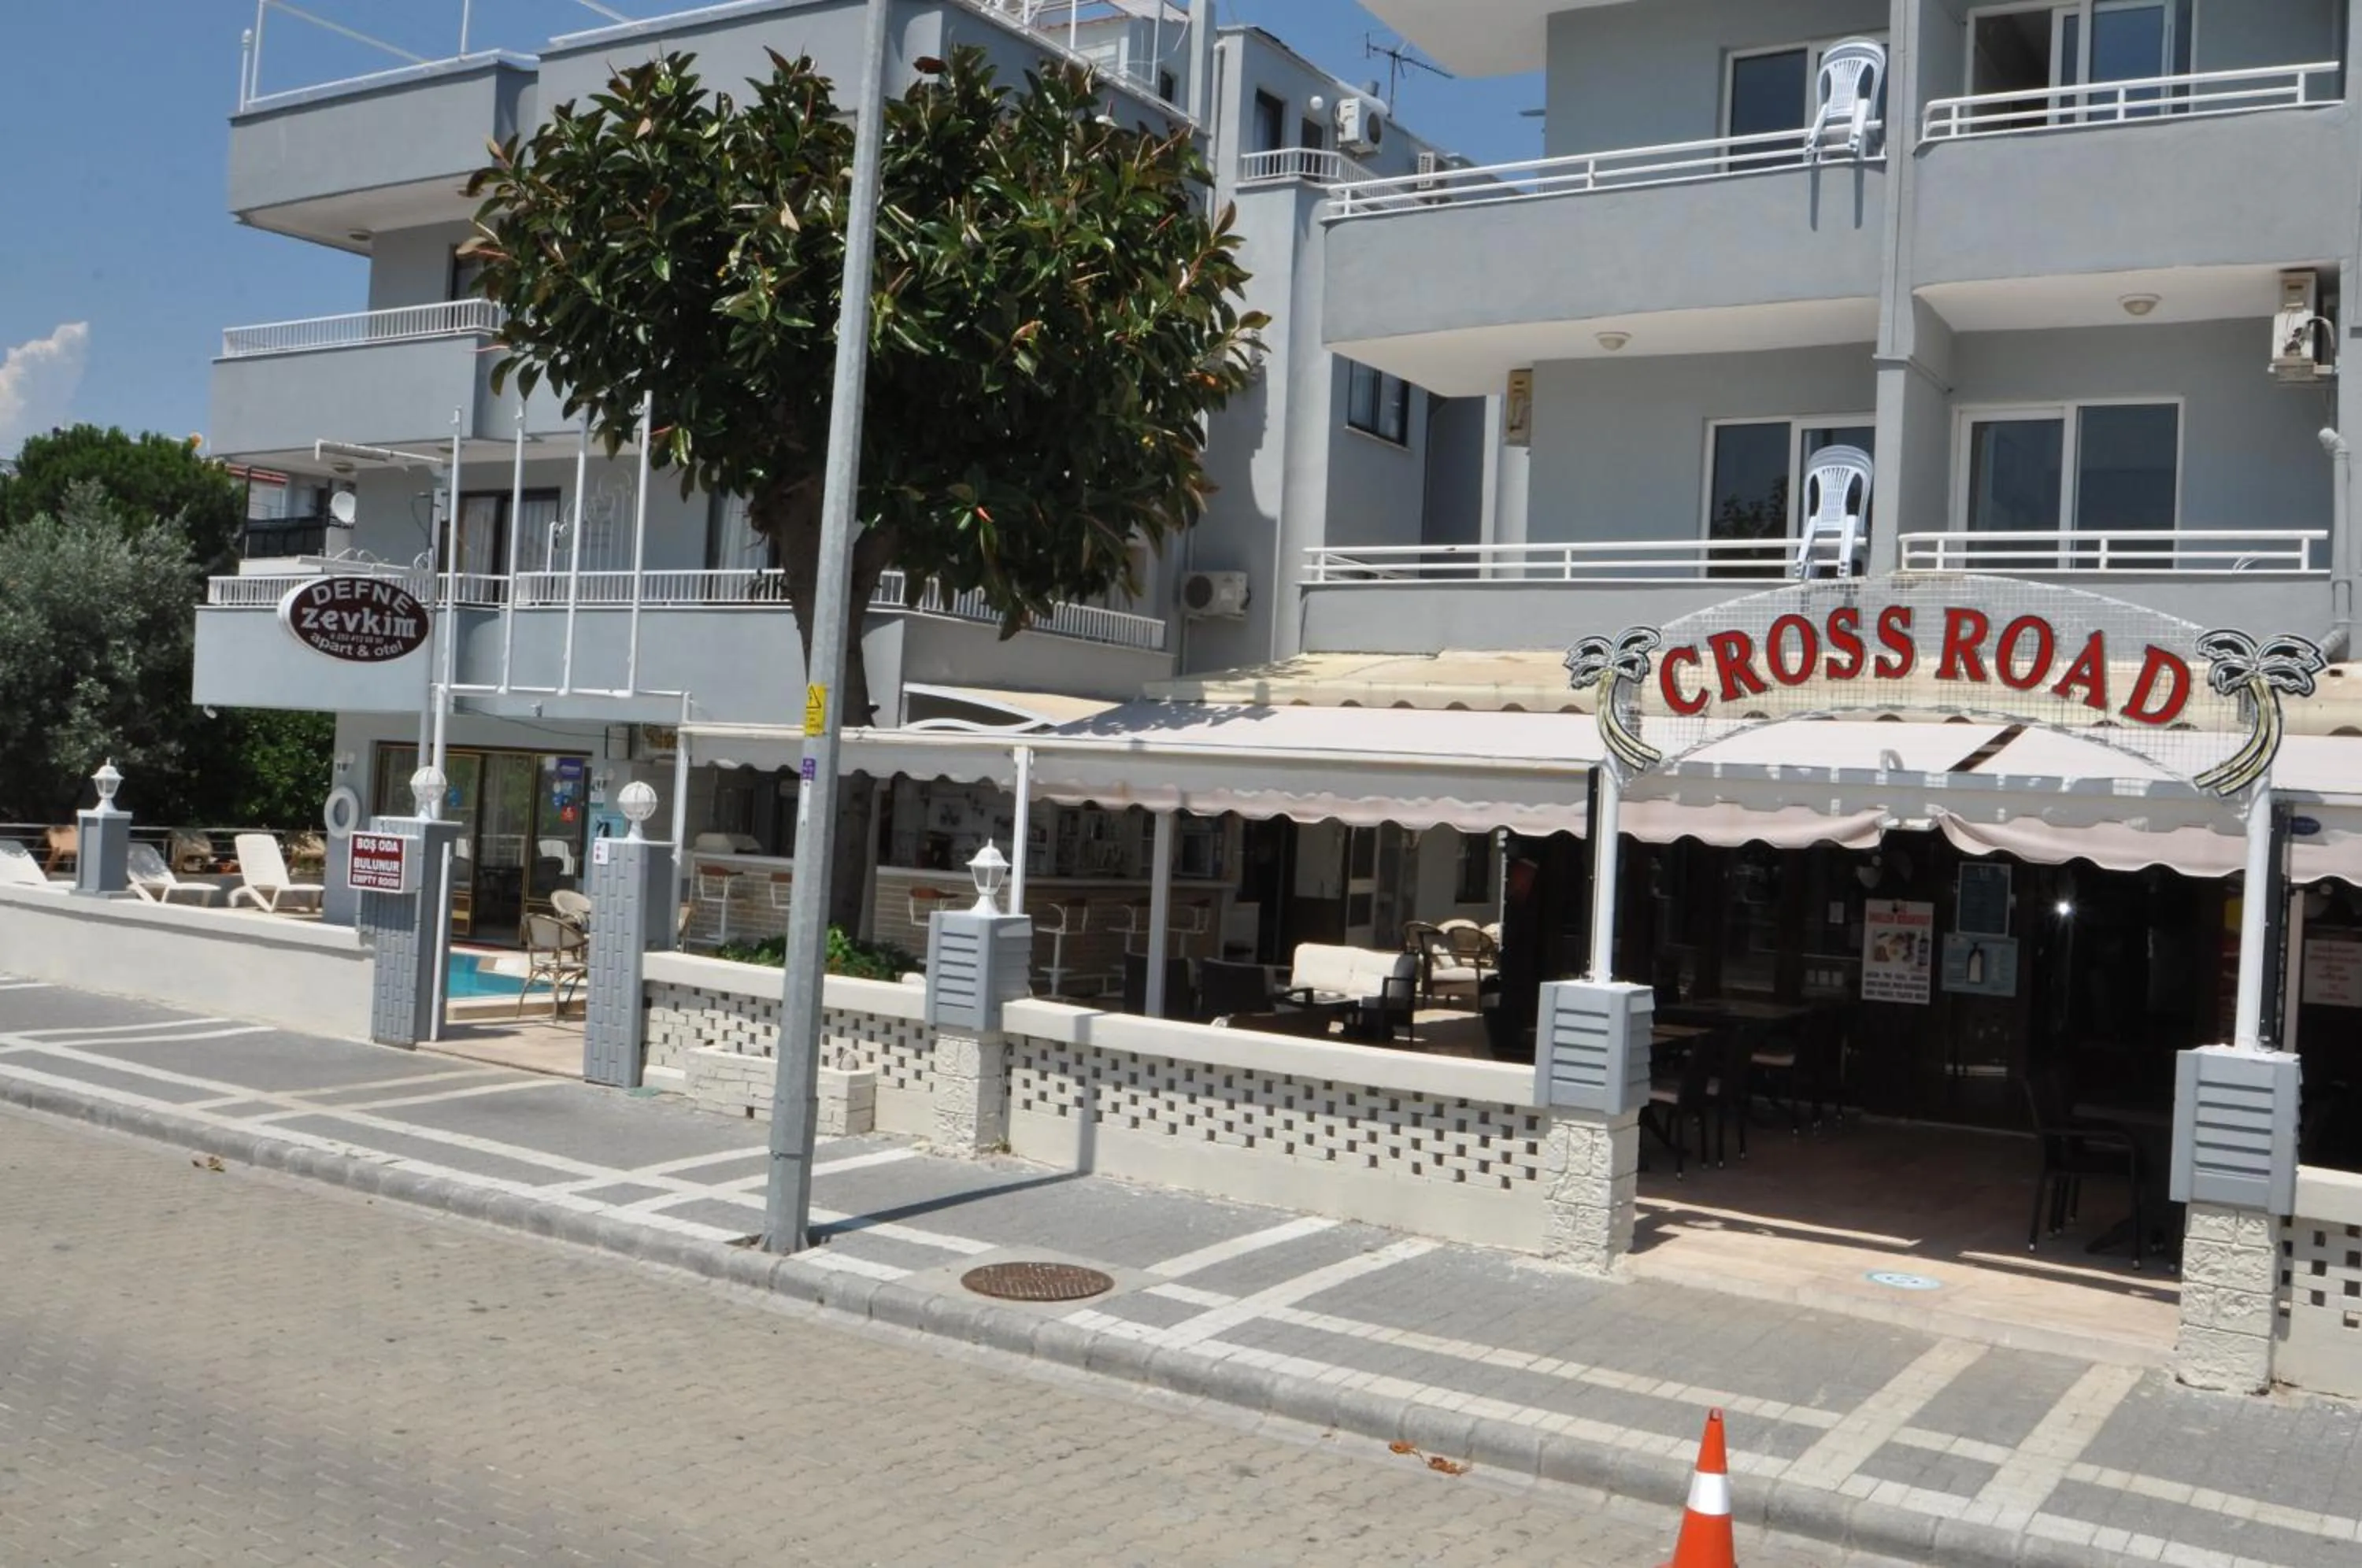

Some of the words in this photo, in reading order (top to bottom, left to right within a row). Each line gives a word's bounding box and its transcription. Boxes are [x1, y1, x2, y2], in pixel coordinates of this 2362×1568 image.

[312, 580, 413, 616] DEFNE
[301, 607, 416, 638] zevkim
[310, 633, 354, 656] apart
[357, 645, 370, 657] &
[1659, 605, 1917, 716] CROSS
[1934, 606, 2192, 725] ROAD
[356, 837, 376, 853] BOŞ
[379, 839, 399, 853] ODA
